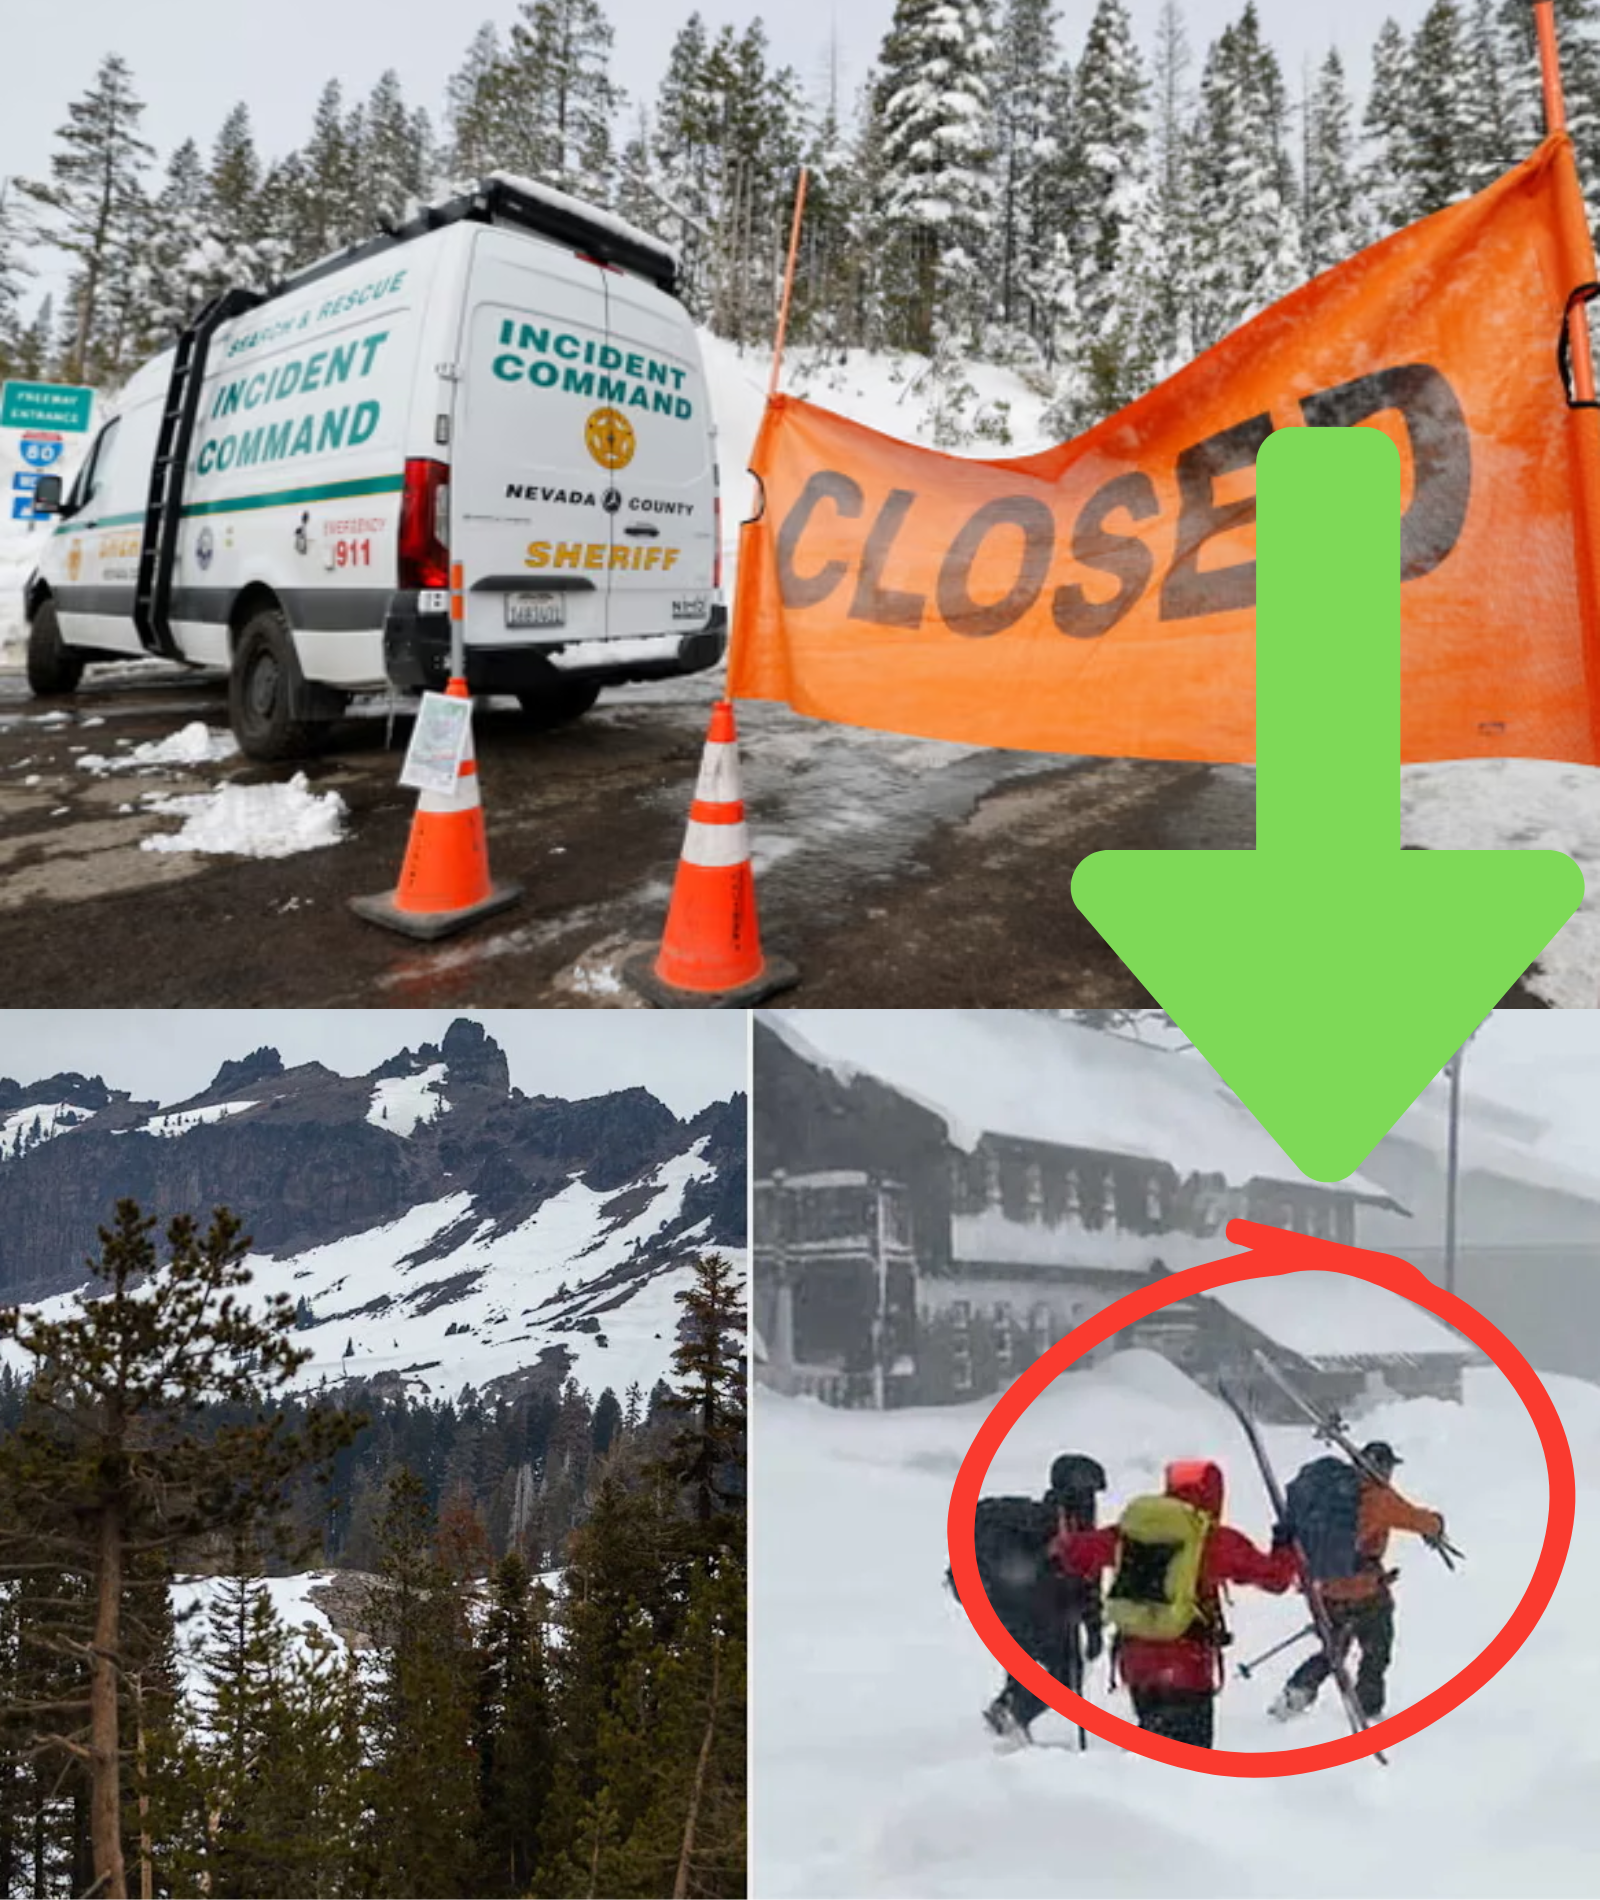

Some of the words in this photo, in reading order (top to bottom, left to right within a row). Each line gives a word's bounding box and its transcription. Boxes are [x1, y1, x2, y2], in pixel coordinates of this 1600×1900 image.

[227, 317, 295, 358] SEARCH
[317, 269, 408, 322] RESCUE
[211, 330, 390, 420] INCIDENT
[499, 318, 687, 391] INCIDENT
[17, 391, 79, 406] FREEWAY
[491, 353, 693, 421] COMMAND
[10, 407, 80, 424] ENTRANCE
[196, 399, 381, 476] COMMAND
[26, 443, 55, 461] 80
[505, 483, 596, 507] NEVADA
[628, 497, 695, 517] COUNTY
[776, 361, 1472, 639] CLOSED
[335, 538, 371, 568] 911
[524, 540, 682, 572] SHERIFF
